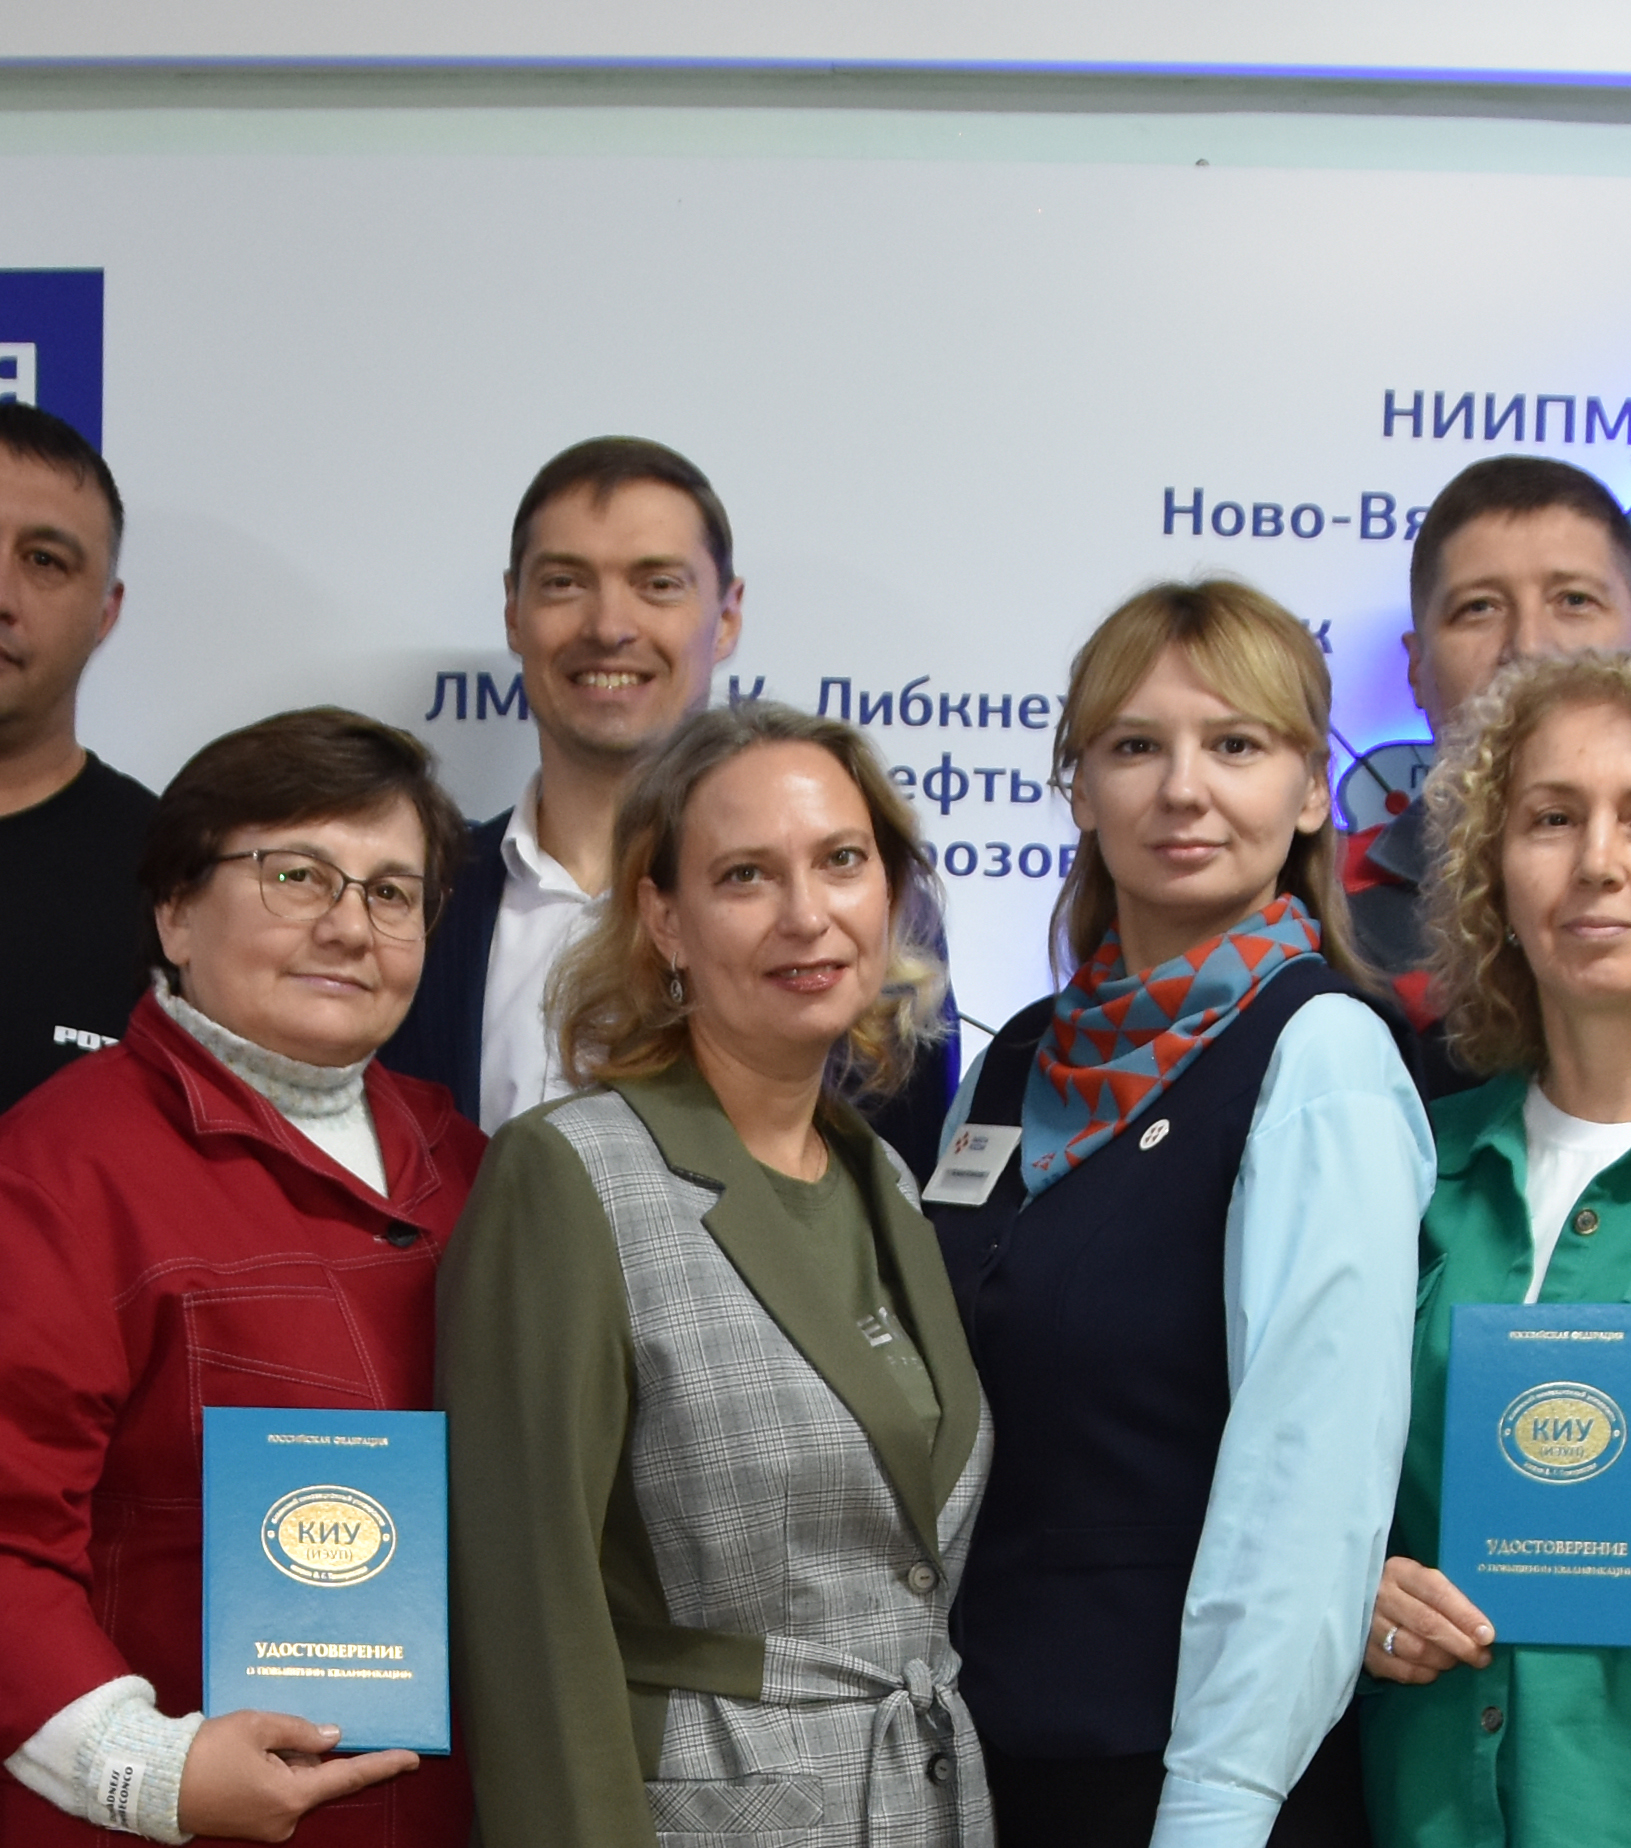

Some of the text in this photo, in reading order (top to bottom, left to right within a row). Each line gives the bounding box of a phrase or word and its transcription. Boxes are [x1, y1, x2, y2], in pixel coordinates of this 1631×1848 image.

[1532, 1418, 1595, 1443] КИУ
[297, 1520, 361, 1545] КИУ
[1487, 1539, 1629, 1557] УДОСТОВЕРЕНИЕ
[254, 1641, 404, 1660] УДОСТОВЕРЕНИЕ
